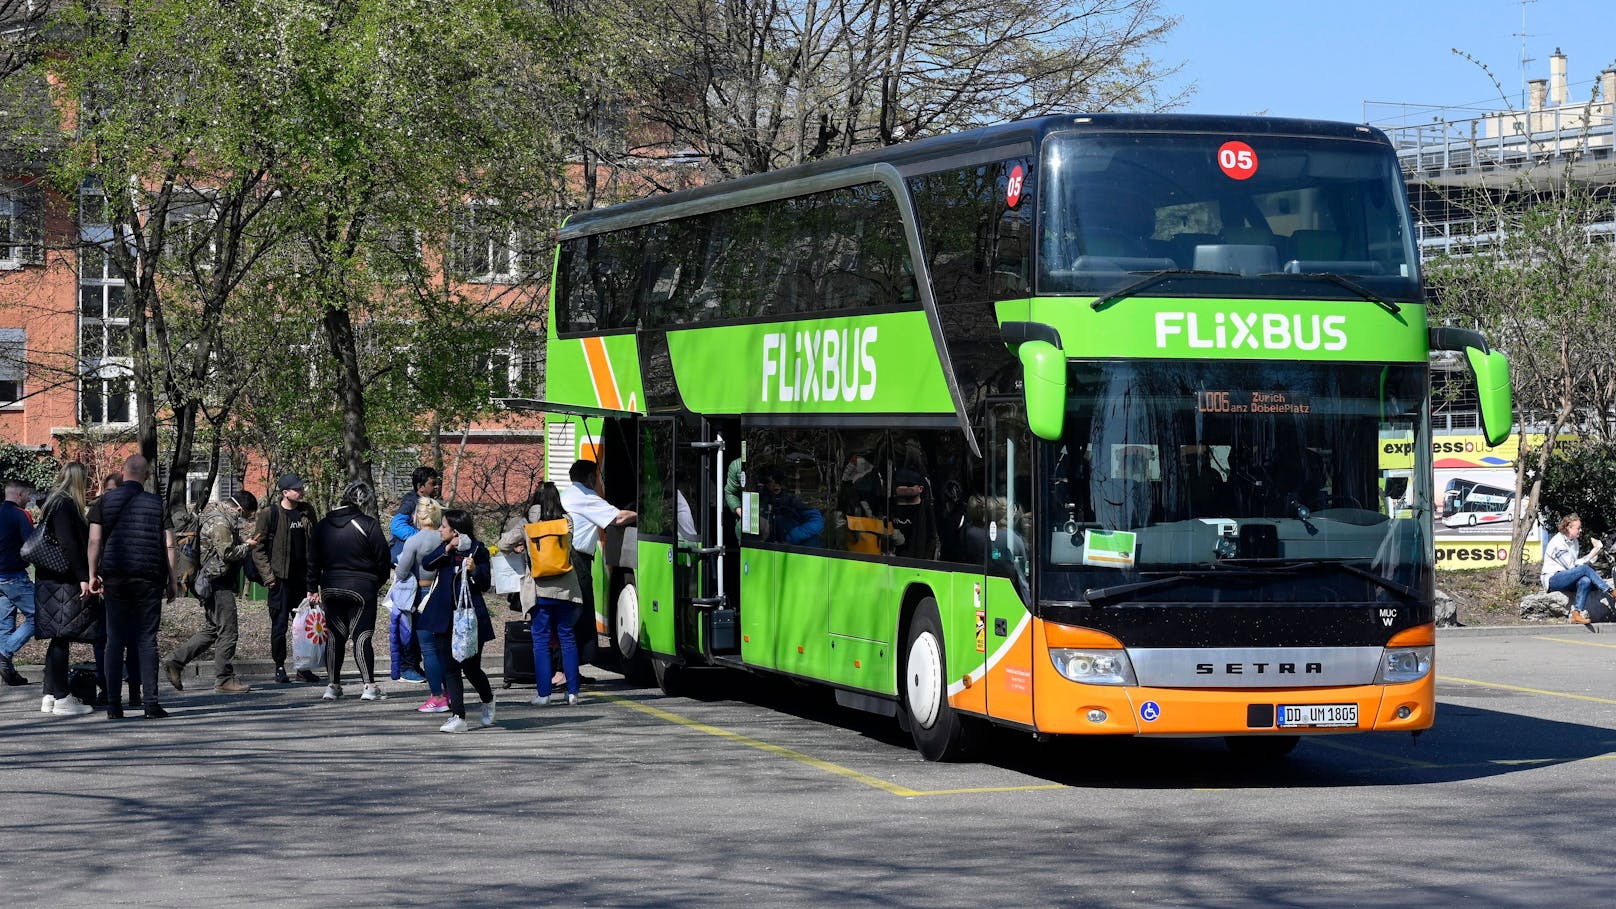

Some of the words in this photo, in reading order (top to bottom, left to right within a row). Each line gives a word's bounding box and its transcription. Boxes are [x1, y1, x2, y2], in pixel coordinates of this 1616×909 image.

[1220, 149, 1253, 170] 05
[1007, 176, 1021, 197] 05
[1379, 608, 1397, 617] MUC
[1382, 617, 1394, 627] W
[1196, 662, 1322, 675] SETRA
[1286, 708, 1301, 722] DD
[1310, 708, 1325, 721] UM
[1328, 707, 1356, 721] 1805
